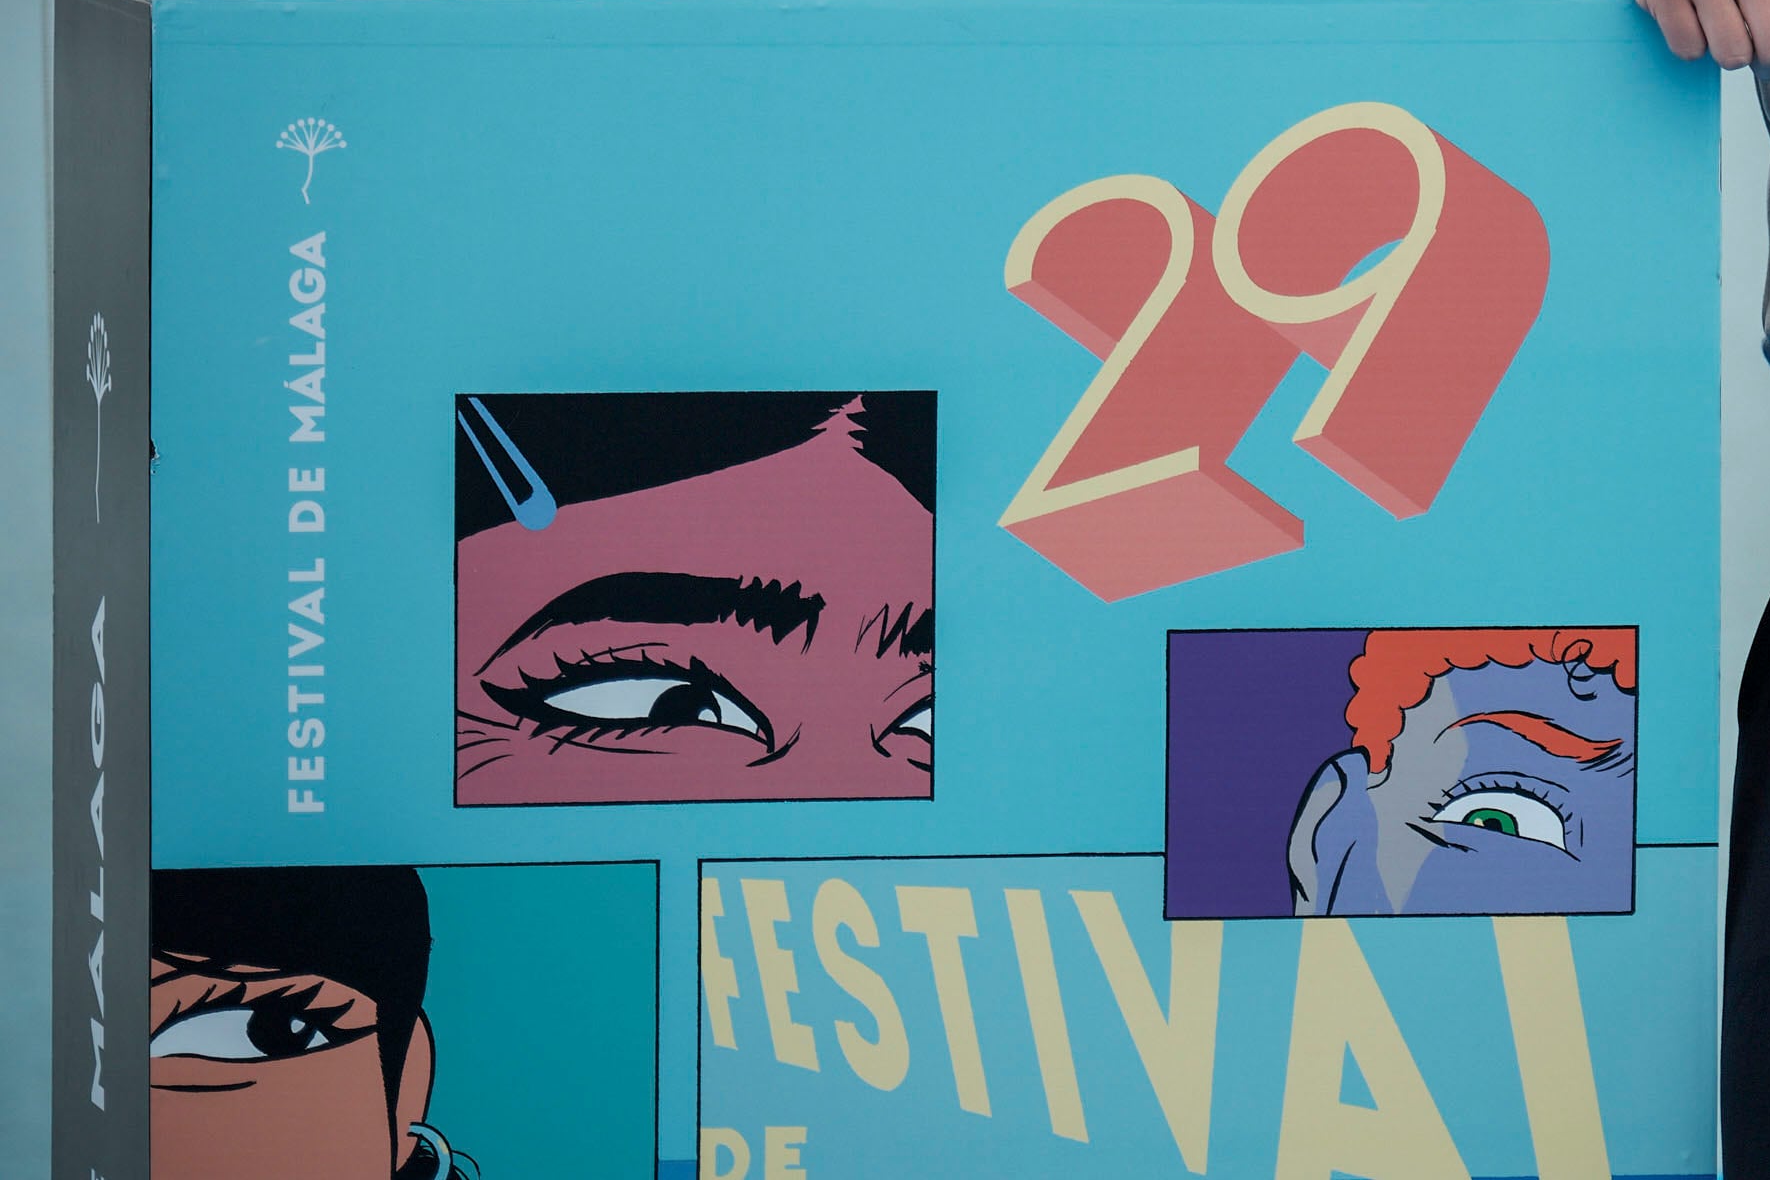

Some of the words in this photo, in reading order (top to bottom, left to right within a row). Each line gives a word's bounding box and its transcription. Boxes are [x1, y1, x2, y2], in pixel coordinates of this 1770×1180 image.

[283, 231, 327, 442] MÁLAGA
[996, 100, 1551, 604] 29
[288, 467, 325, 533] DE
[287, 558, 326, 813] FESTIVAL
[700, 1126, 808, 1180] DE
